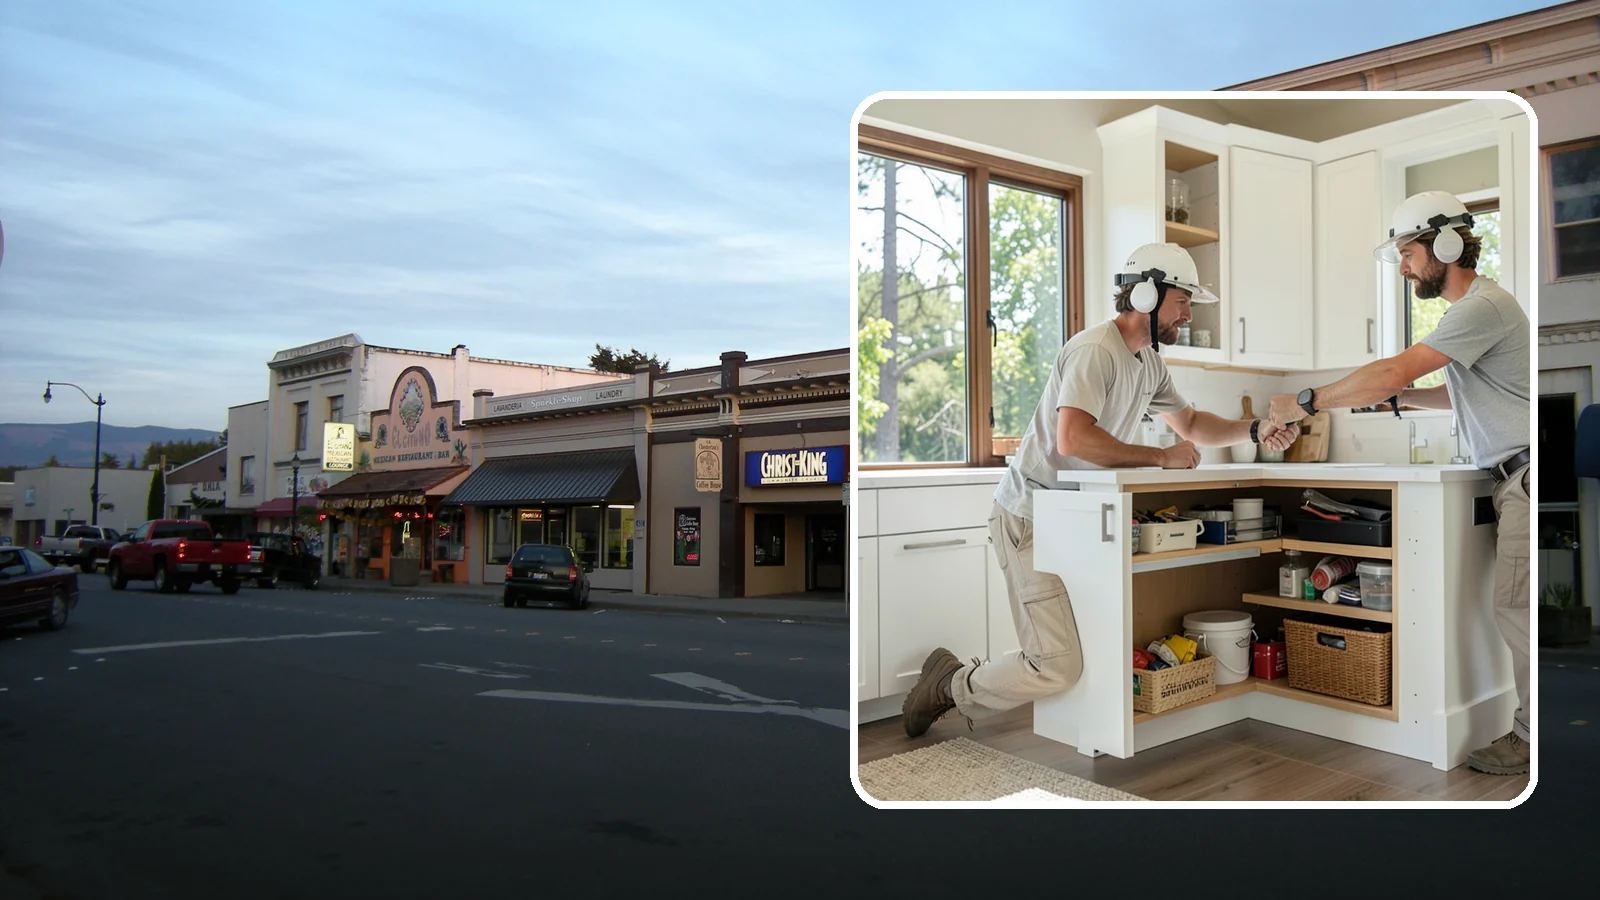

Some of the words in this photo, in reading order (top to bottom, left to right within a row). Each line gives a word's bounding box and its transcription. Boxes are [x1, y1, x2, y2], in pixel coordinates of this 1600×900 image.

[561, 394, 583, 406] Shop
[595, 389, 624, 400] LAUNDRY
[493, 402, 523, 413] LAVANDERIA
[373, 454, 396, 464] MEXICAN
[397, 451, 433, 462] RESTAURANT
[437, 450, 450, 459] BAR
[761, 452, 797, 478] CHRIST
[799, 450, 827, 476] KING
